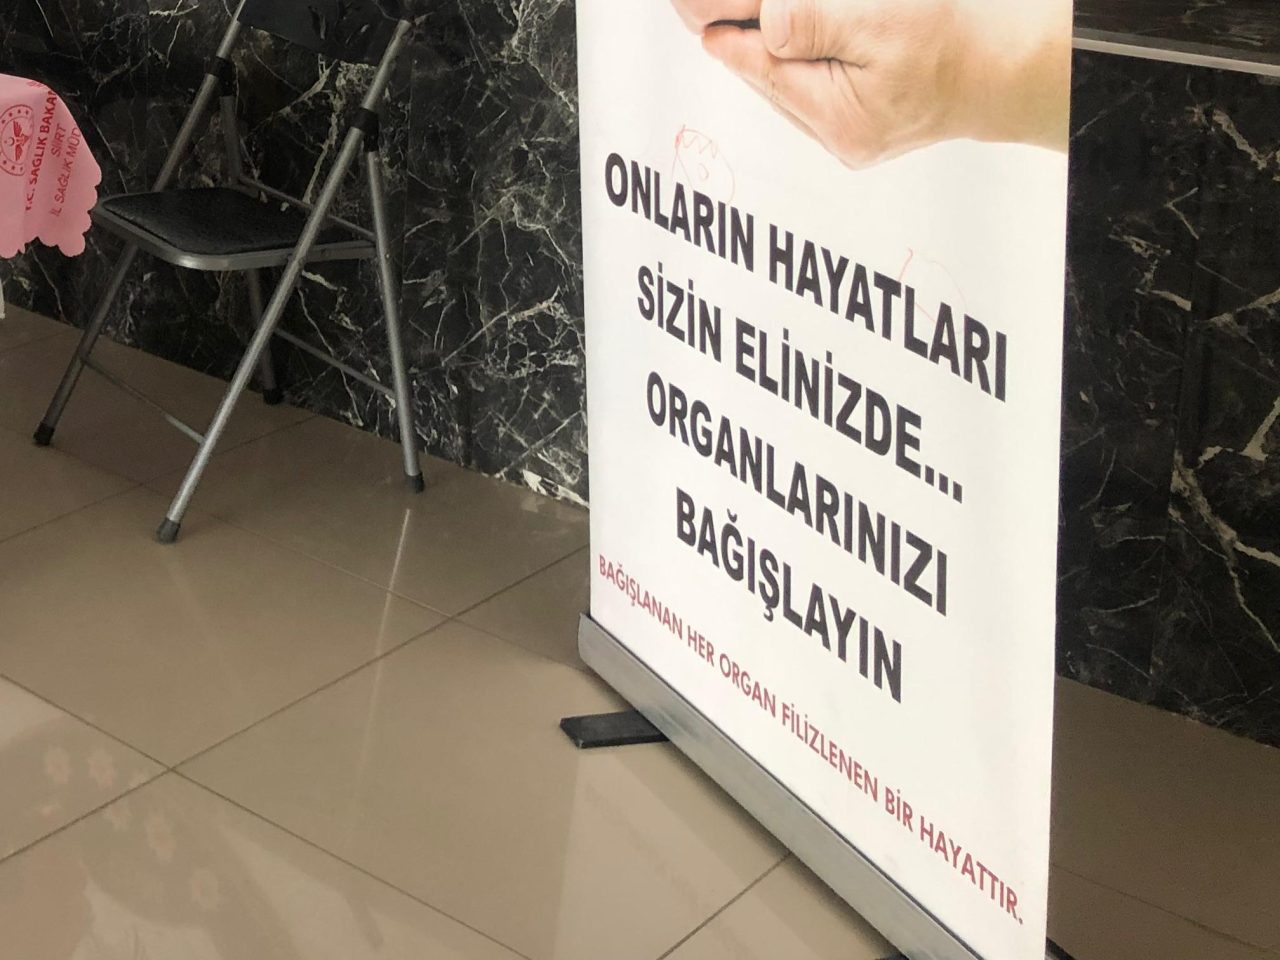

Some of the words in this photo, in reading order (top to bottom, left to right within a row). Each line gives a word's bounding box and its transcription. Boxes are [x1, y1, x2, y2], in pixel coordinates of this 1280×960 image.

[605, 152, 754, 273] ONLARIN
[769, 223, 1007, 403] HAYATLARI
[637, 261, 721, 363] SİZİN
[735, 317, 963, 504] ELİNİZDE...
[646, 371, 947, 616] ORGANLARINIZI
[676, 486, 901, 704] BAĞIŞLAYIN
[599, 554, 682, 641] BAĞIŞLANAN
[687, 624, 715, 667] HER
[719, 653, 776, 718] ORGAN
[782, 702, 878, 802] FİLİZLENEN
[884, 785, 913, 833] BİR
[920, 815, 1024, 925] HAYATTIR.
